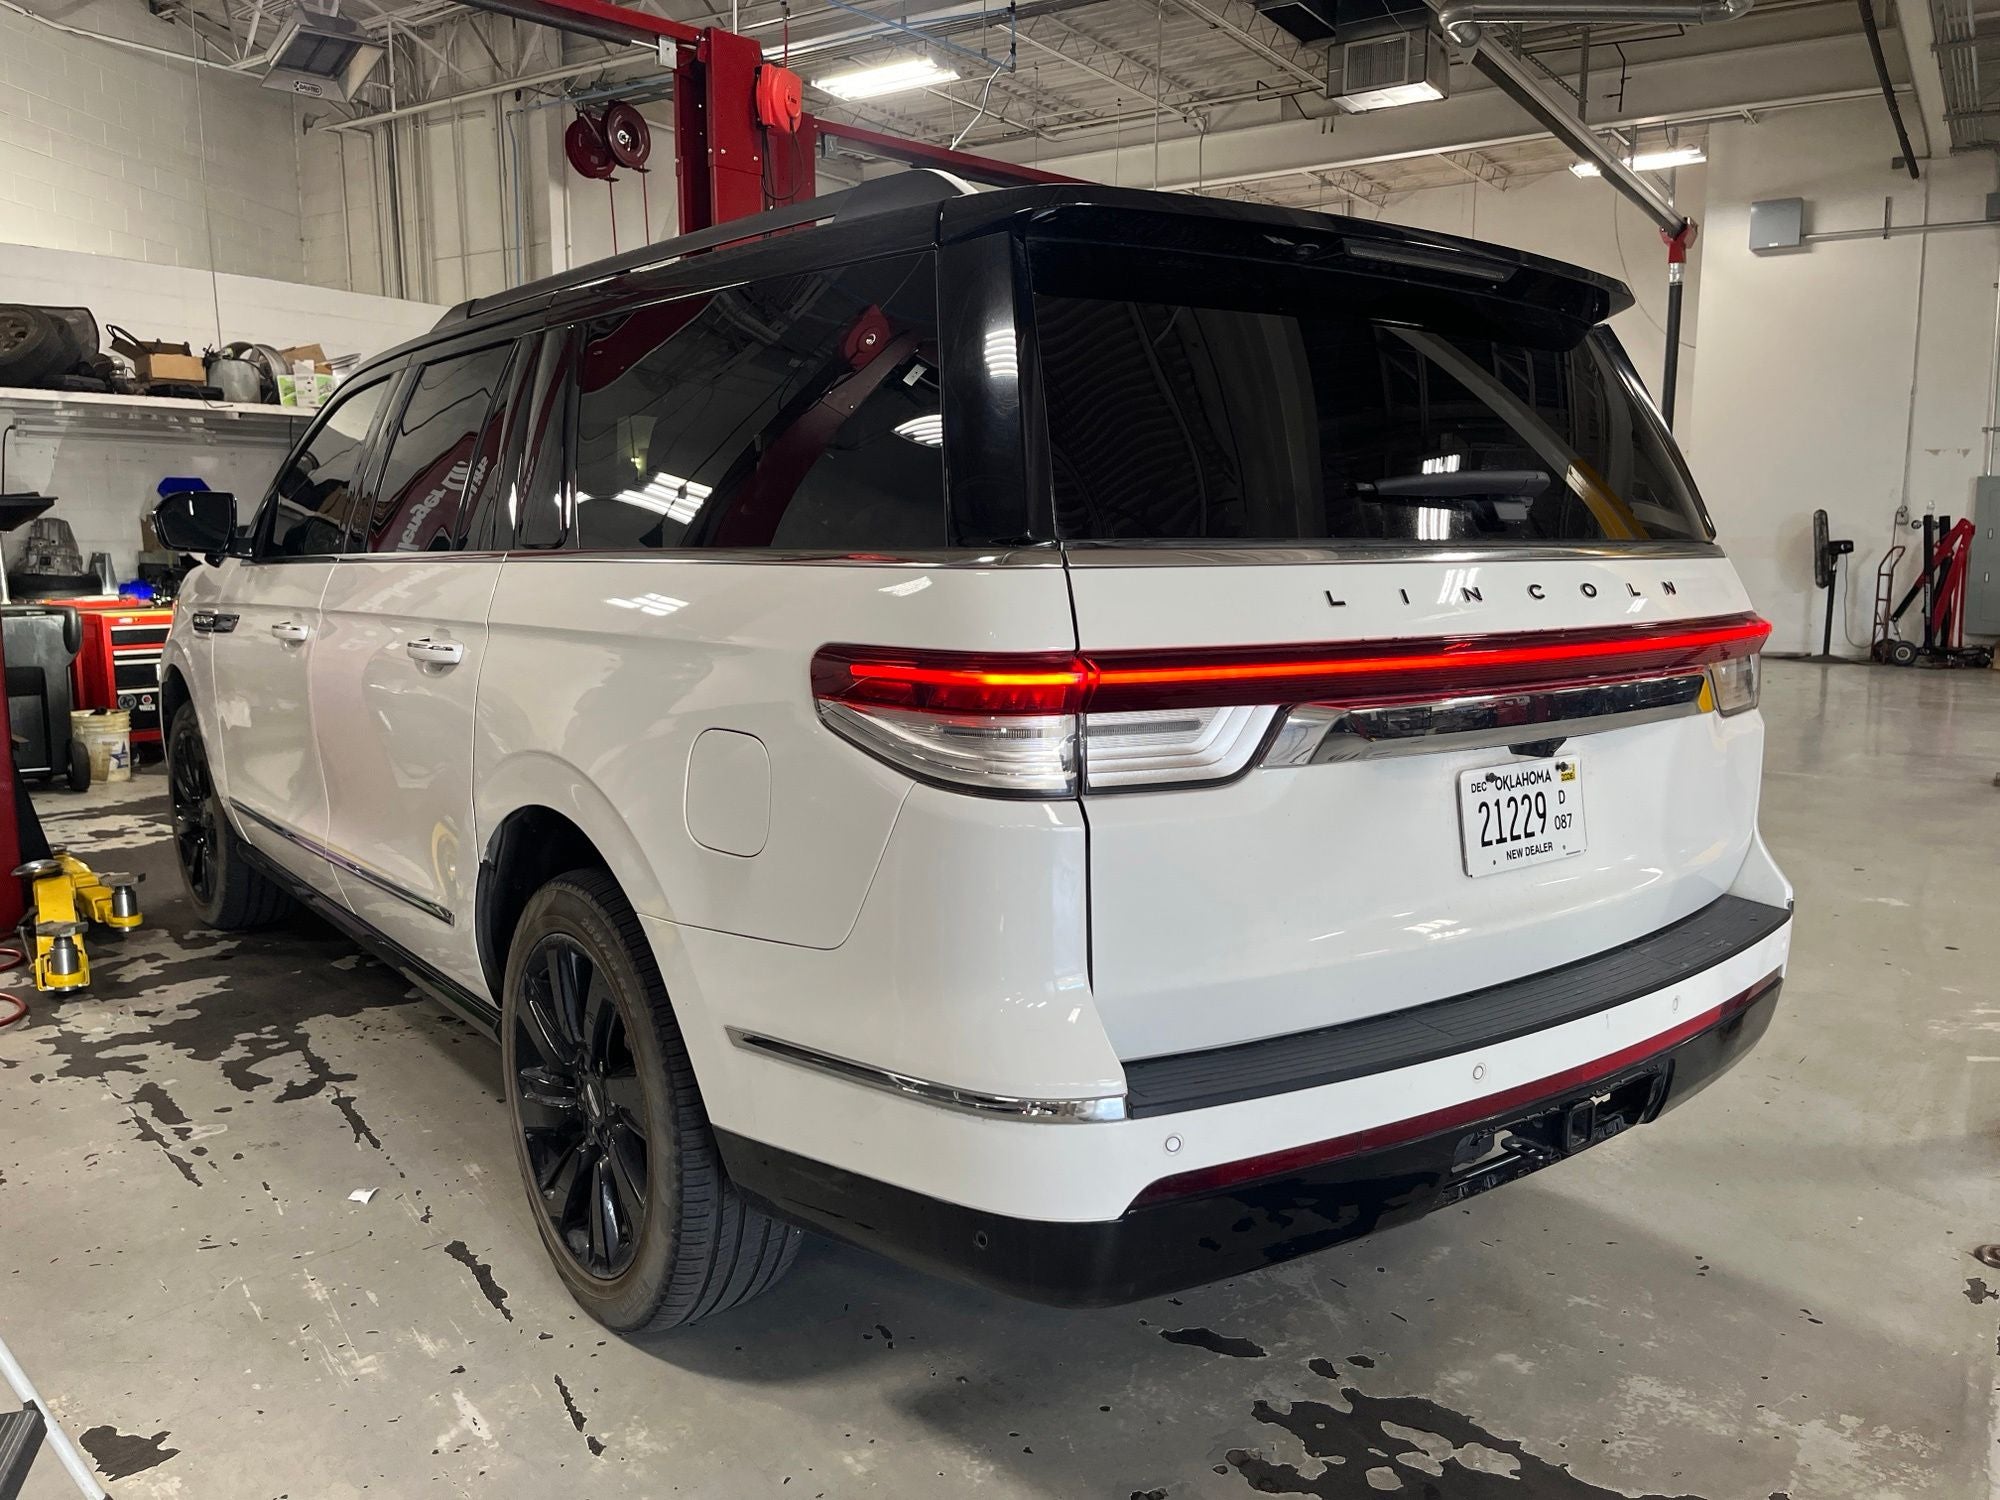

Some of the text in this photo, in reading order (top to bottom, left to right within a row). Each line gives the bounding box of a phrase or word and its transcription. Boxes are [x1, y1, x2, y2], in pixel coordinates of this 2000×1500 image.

[1324, 581, 1677, 607] LINCOLN
[1471, 769, 1552, 793] DEC OKLAHOMA
[1558, 789, 1566, 804] D
[1478, 791, 1547, 848] 21229
[1554, 813, 1573, 830] 087
[1506, 841, 1554, 861] NEW DEALER
